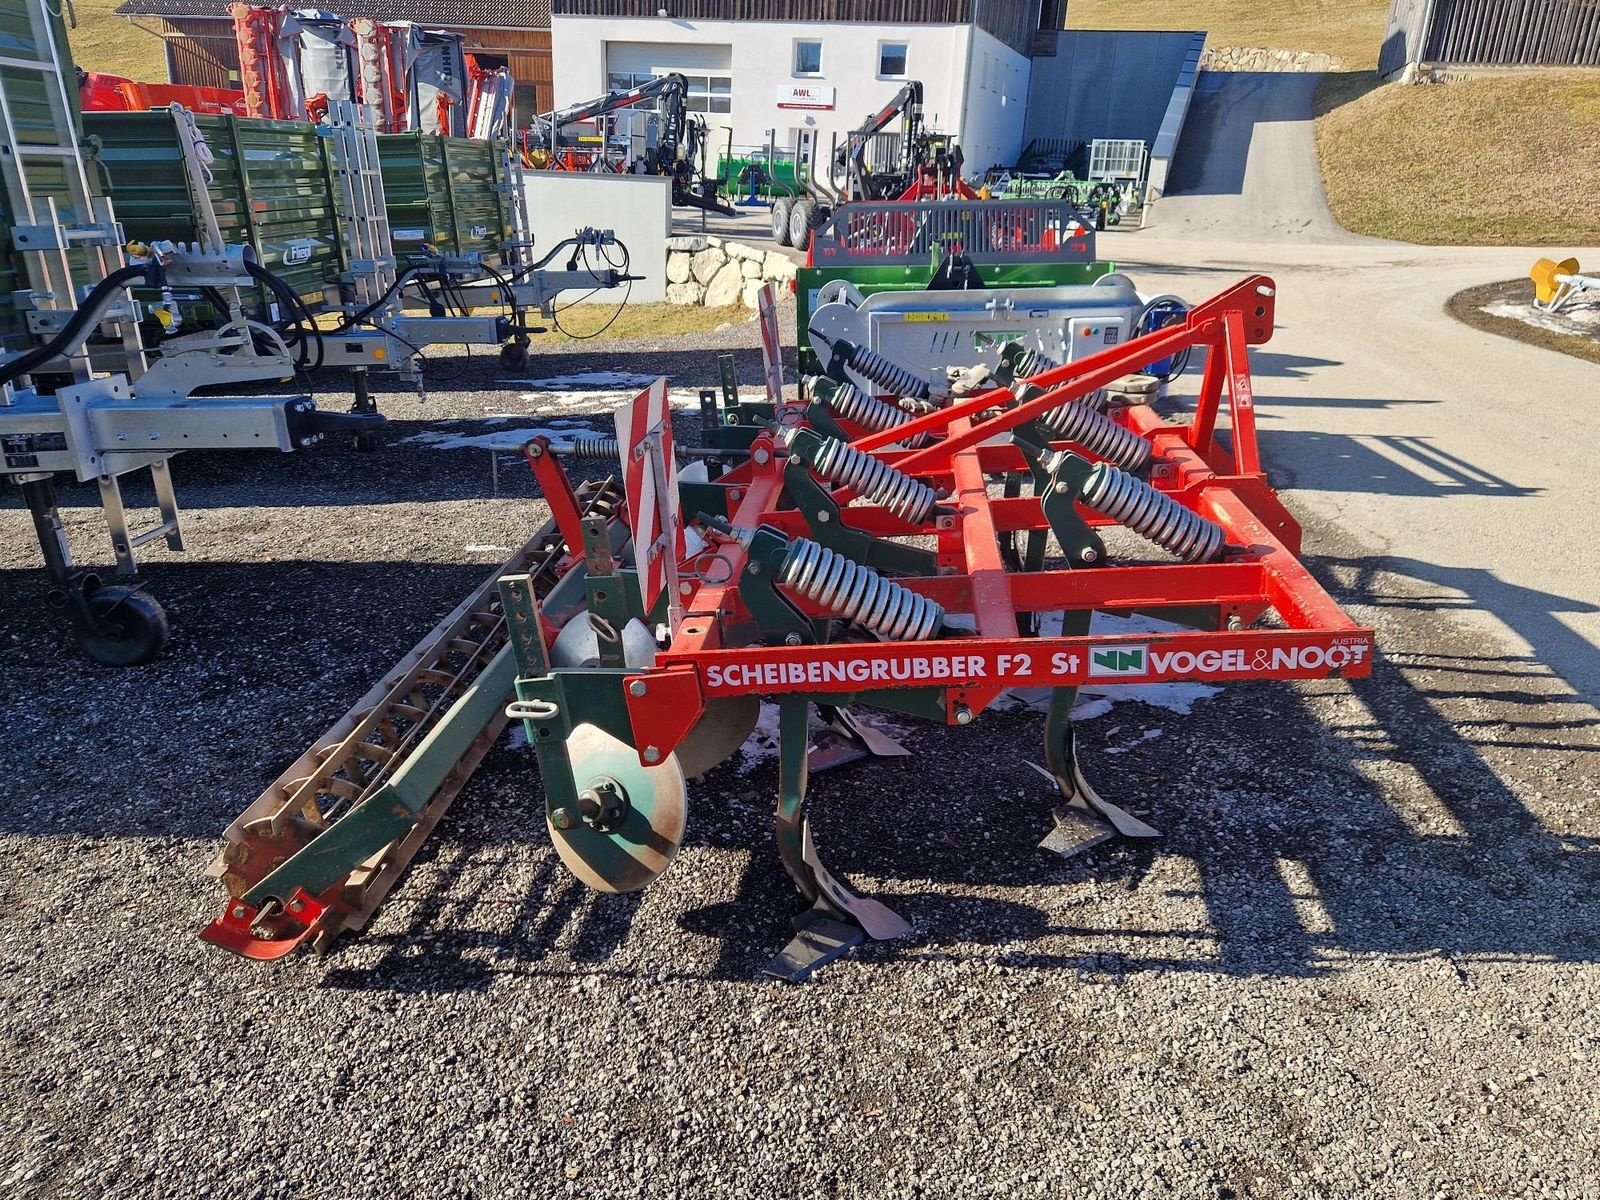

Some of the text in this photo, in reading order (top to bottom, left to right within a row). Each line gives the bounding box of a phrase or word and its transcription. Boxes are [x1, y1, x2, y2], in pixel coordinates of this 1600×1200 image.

[792, 88, 811, 97] AWL
[1331, 637, 1369, 645] AUSTRIA
[706, 655, 986, 688] SCHEIBENGRUBBER
[997, 652, 1032, 676] F2
[1050, 651, 1080, 674] St
[1150, 645, 1369, 675] VOGEL&NOOT
